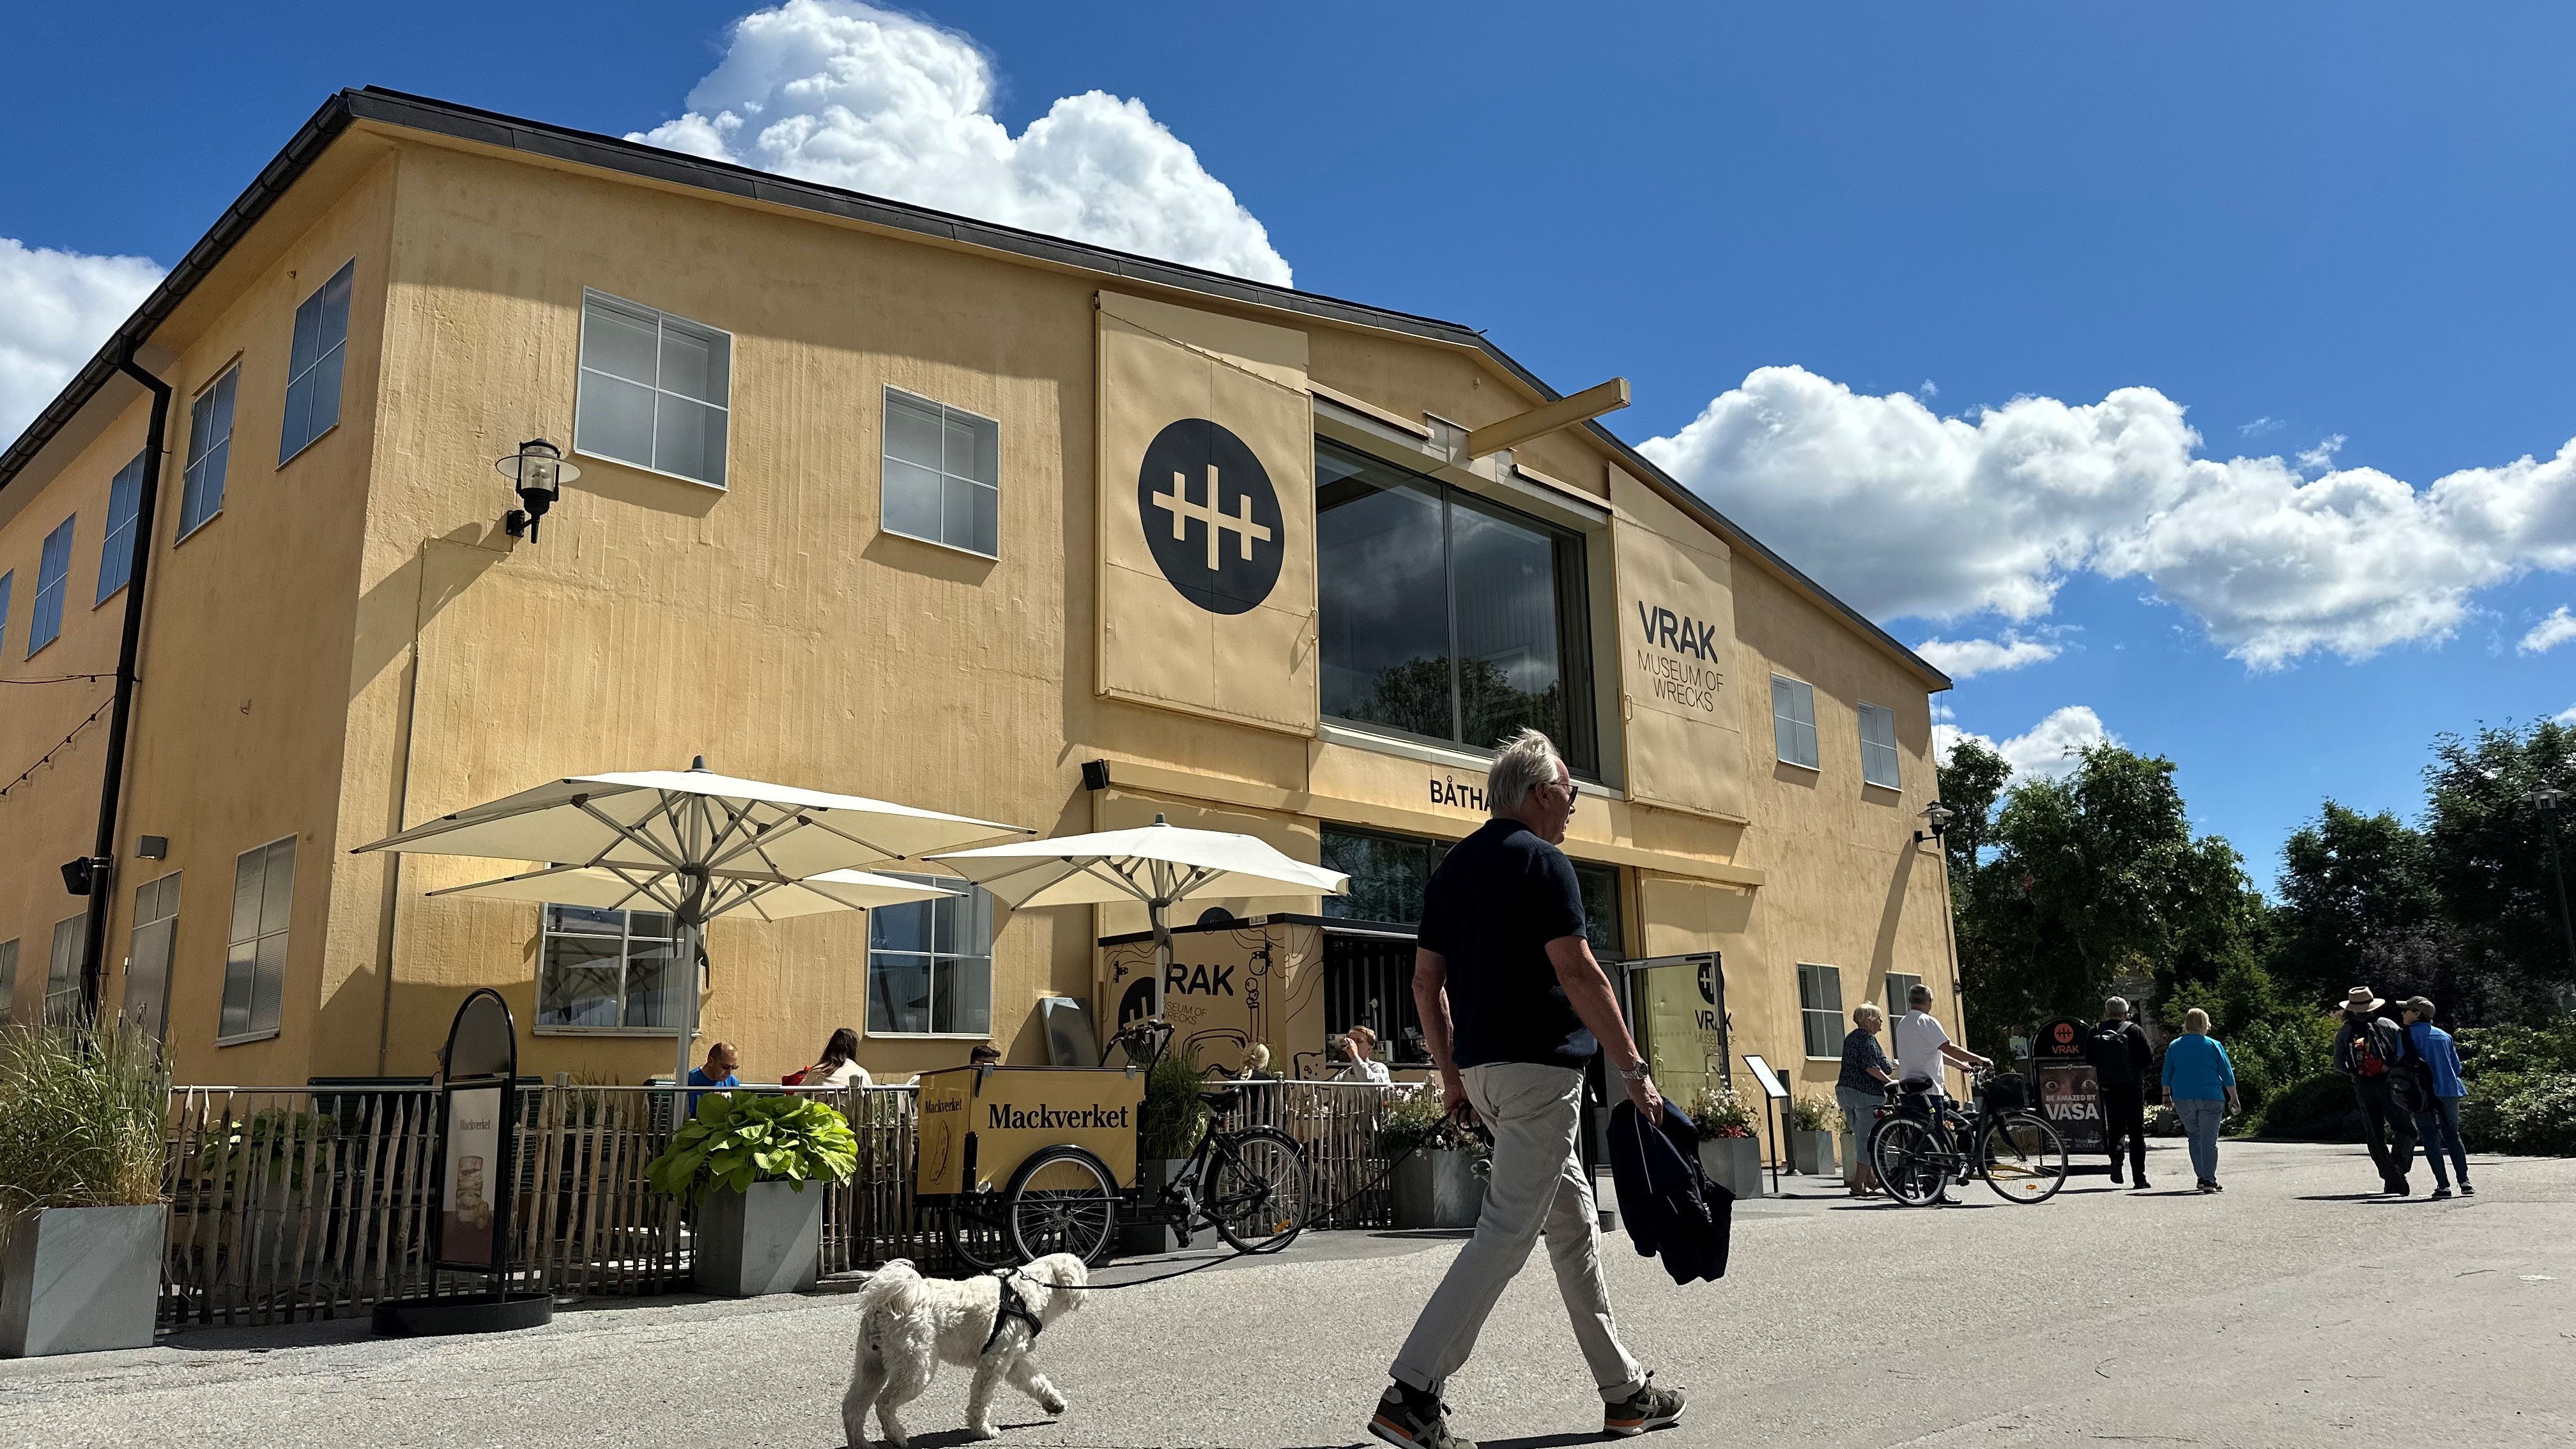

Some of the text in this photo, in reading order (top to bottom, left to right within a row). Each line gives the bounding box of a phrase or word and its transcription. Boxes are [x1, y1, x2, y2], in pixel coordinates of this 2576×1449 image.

[1638, 601, 1719, 664] VRAK
[1637, 649, 1724, 693] MUSEUM OF
[1653, 677, 1714, 712] WRECKS
[1164, 963, 1235, 996] RAK
[1163, 999, 1208, 1017] SEUM OF
[1695, 1009, 1733, 1032] VRK
[1695, 1034, 1736, 1046] MUSEU OF
[2052, 1045, 2080, 1054] VRAK
[924, 1098, 963, 1114] Mackverket
[988, 1103, 1129, 1129] Mackverket
[2044, 1103, 2100, 1121] VASA
[459, 1119, 491, 1130] Mackverket
